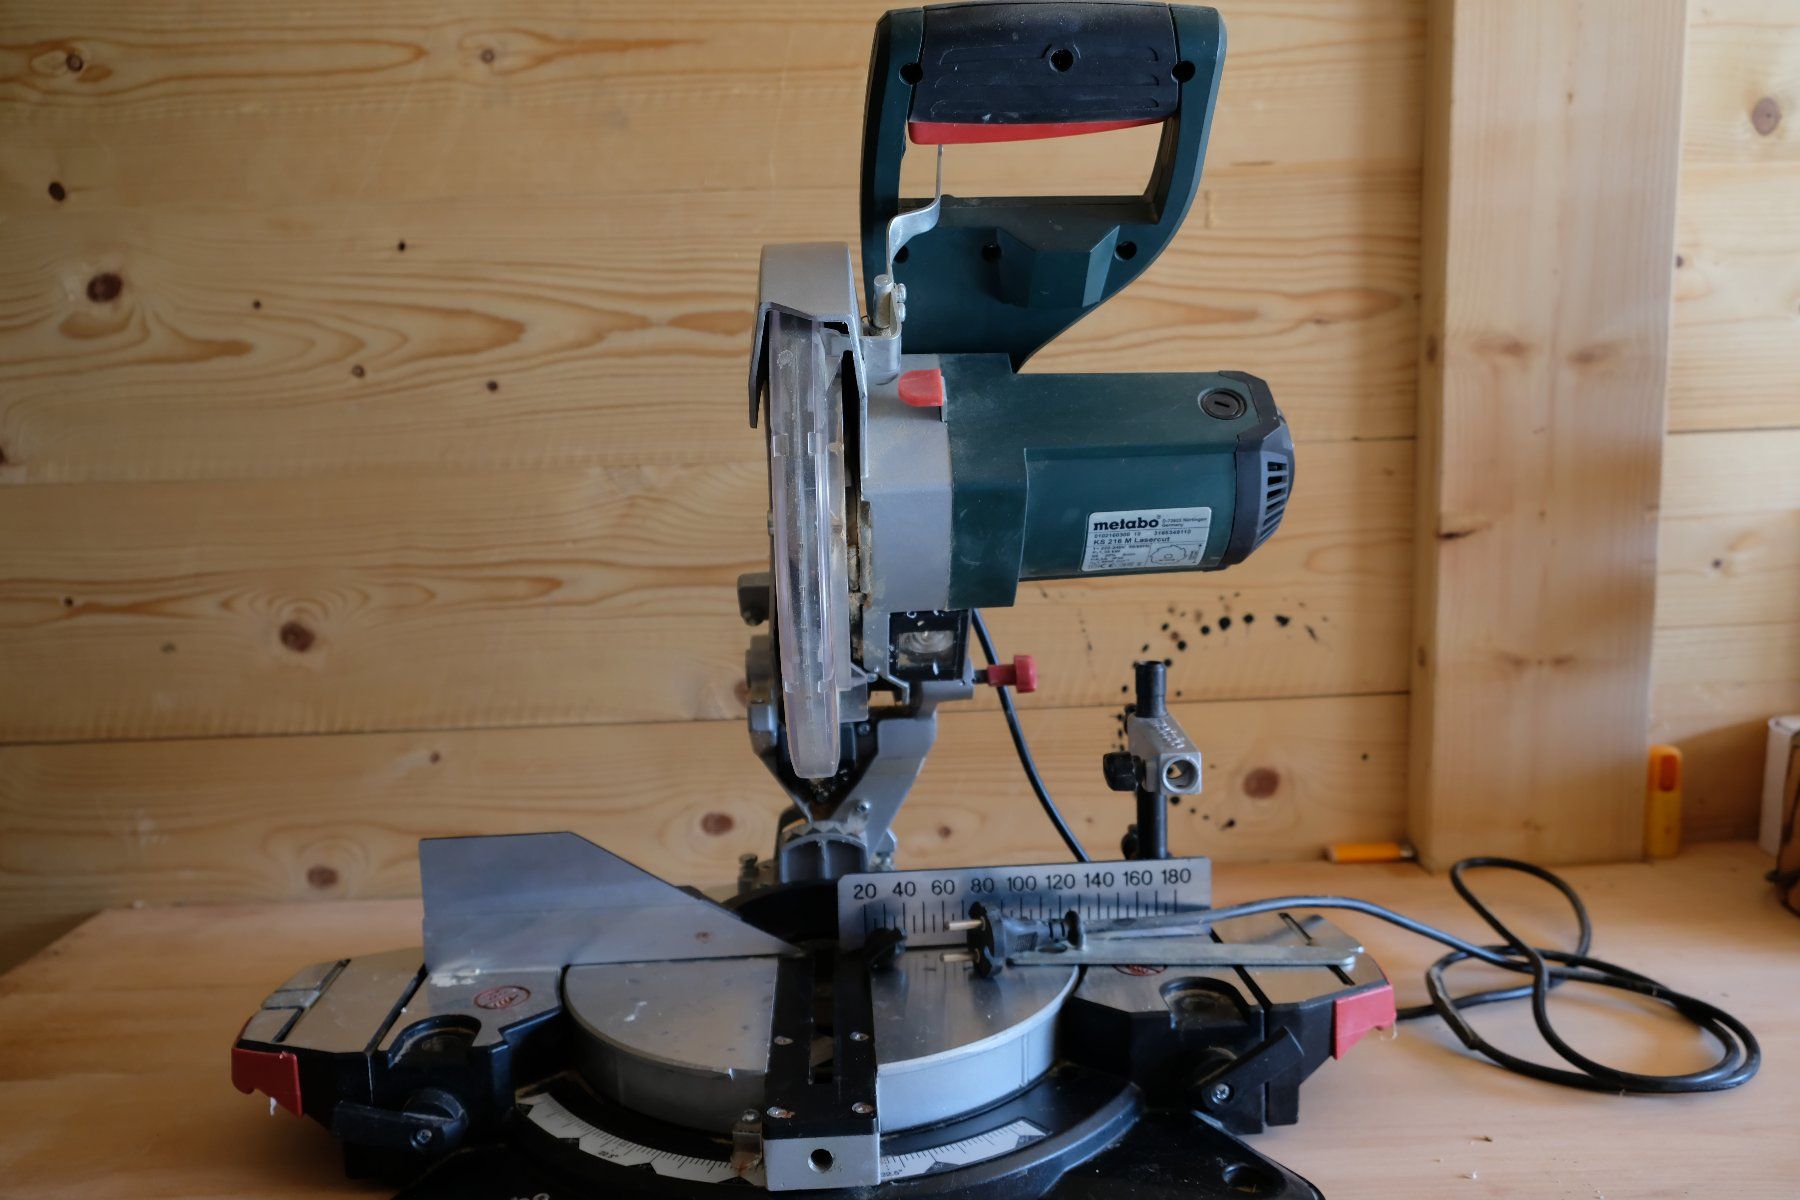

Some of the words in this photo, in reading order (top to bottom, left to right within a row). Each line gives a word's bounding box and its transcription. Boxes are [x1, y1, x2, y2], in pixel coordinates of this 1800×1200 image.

[1093, 517, 1159, 531] metabo
[1093, 537, 1106, 545] KS
[1107, 537, 1122, 545] 216
[853, 883, 877, 900] 20
[891, 881, 917, 898] 40
[930, 879, 956, 896] 60
[970, 877, 996, 894] 80
[1006, 875, 1037, 892] 100
[1046, 873, 1076, 891] 120
[1084, 871, 1115, 889] 140
[1122, 869, 1153, 887] 160
[1161, 867, 1192, 885] 180
